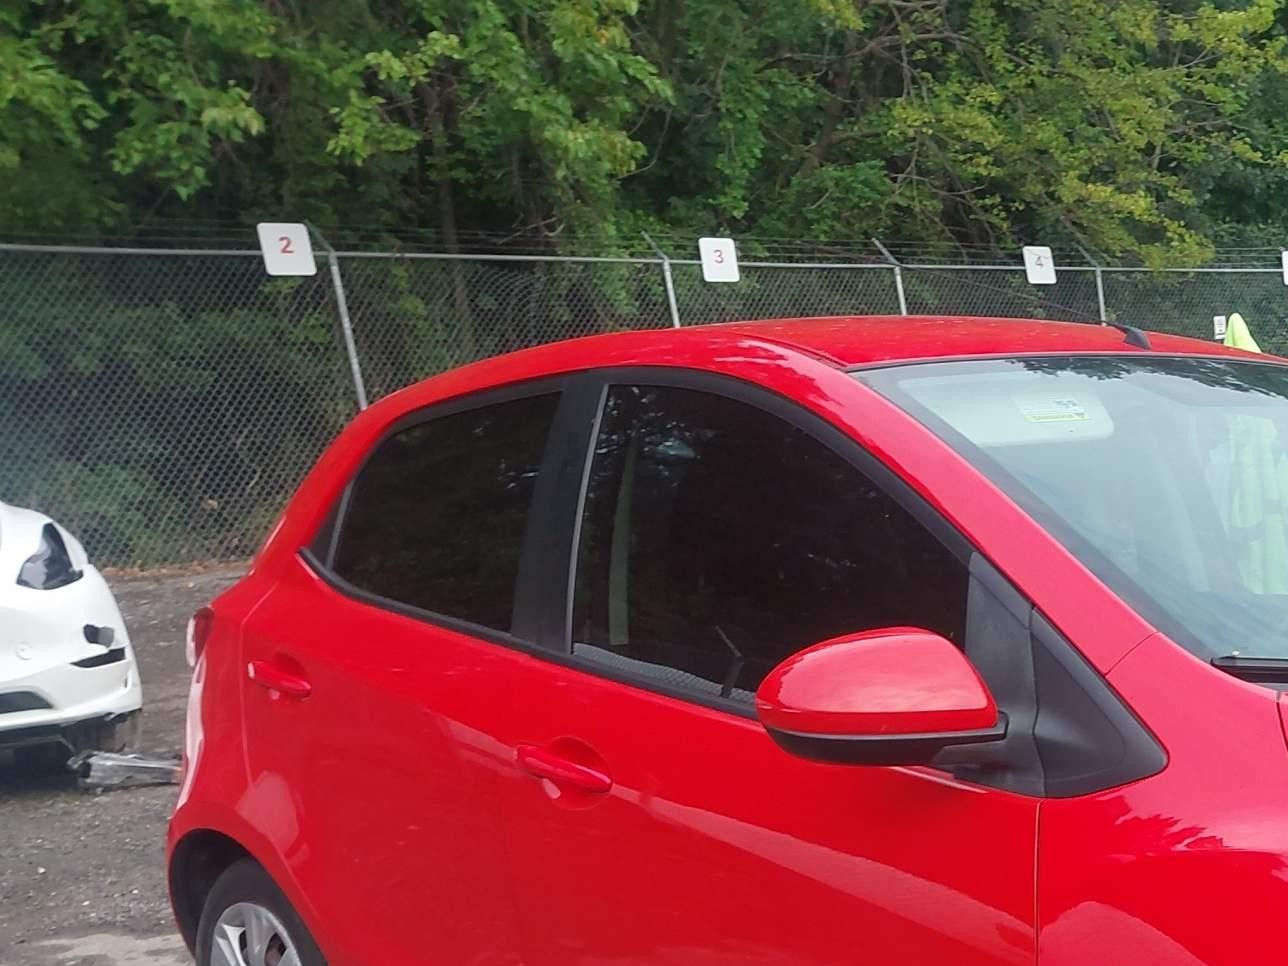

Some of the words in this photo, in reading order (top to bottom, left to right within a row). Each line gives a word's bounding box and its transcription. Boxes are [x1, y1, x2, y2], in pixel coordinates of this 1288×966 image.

[278, 236, 296, 254] 2
[712, 249, 725, 264] 3
[1034, 255, 1045, 270] 4
